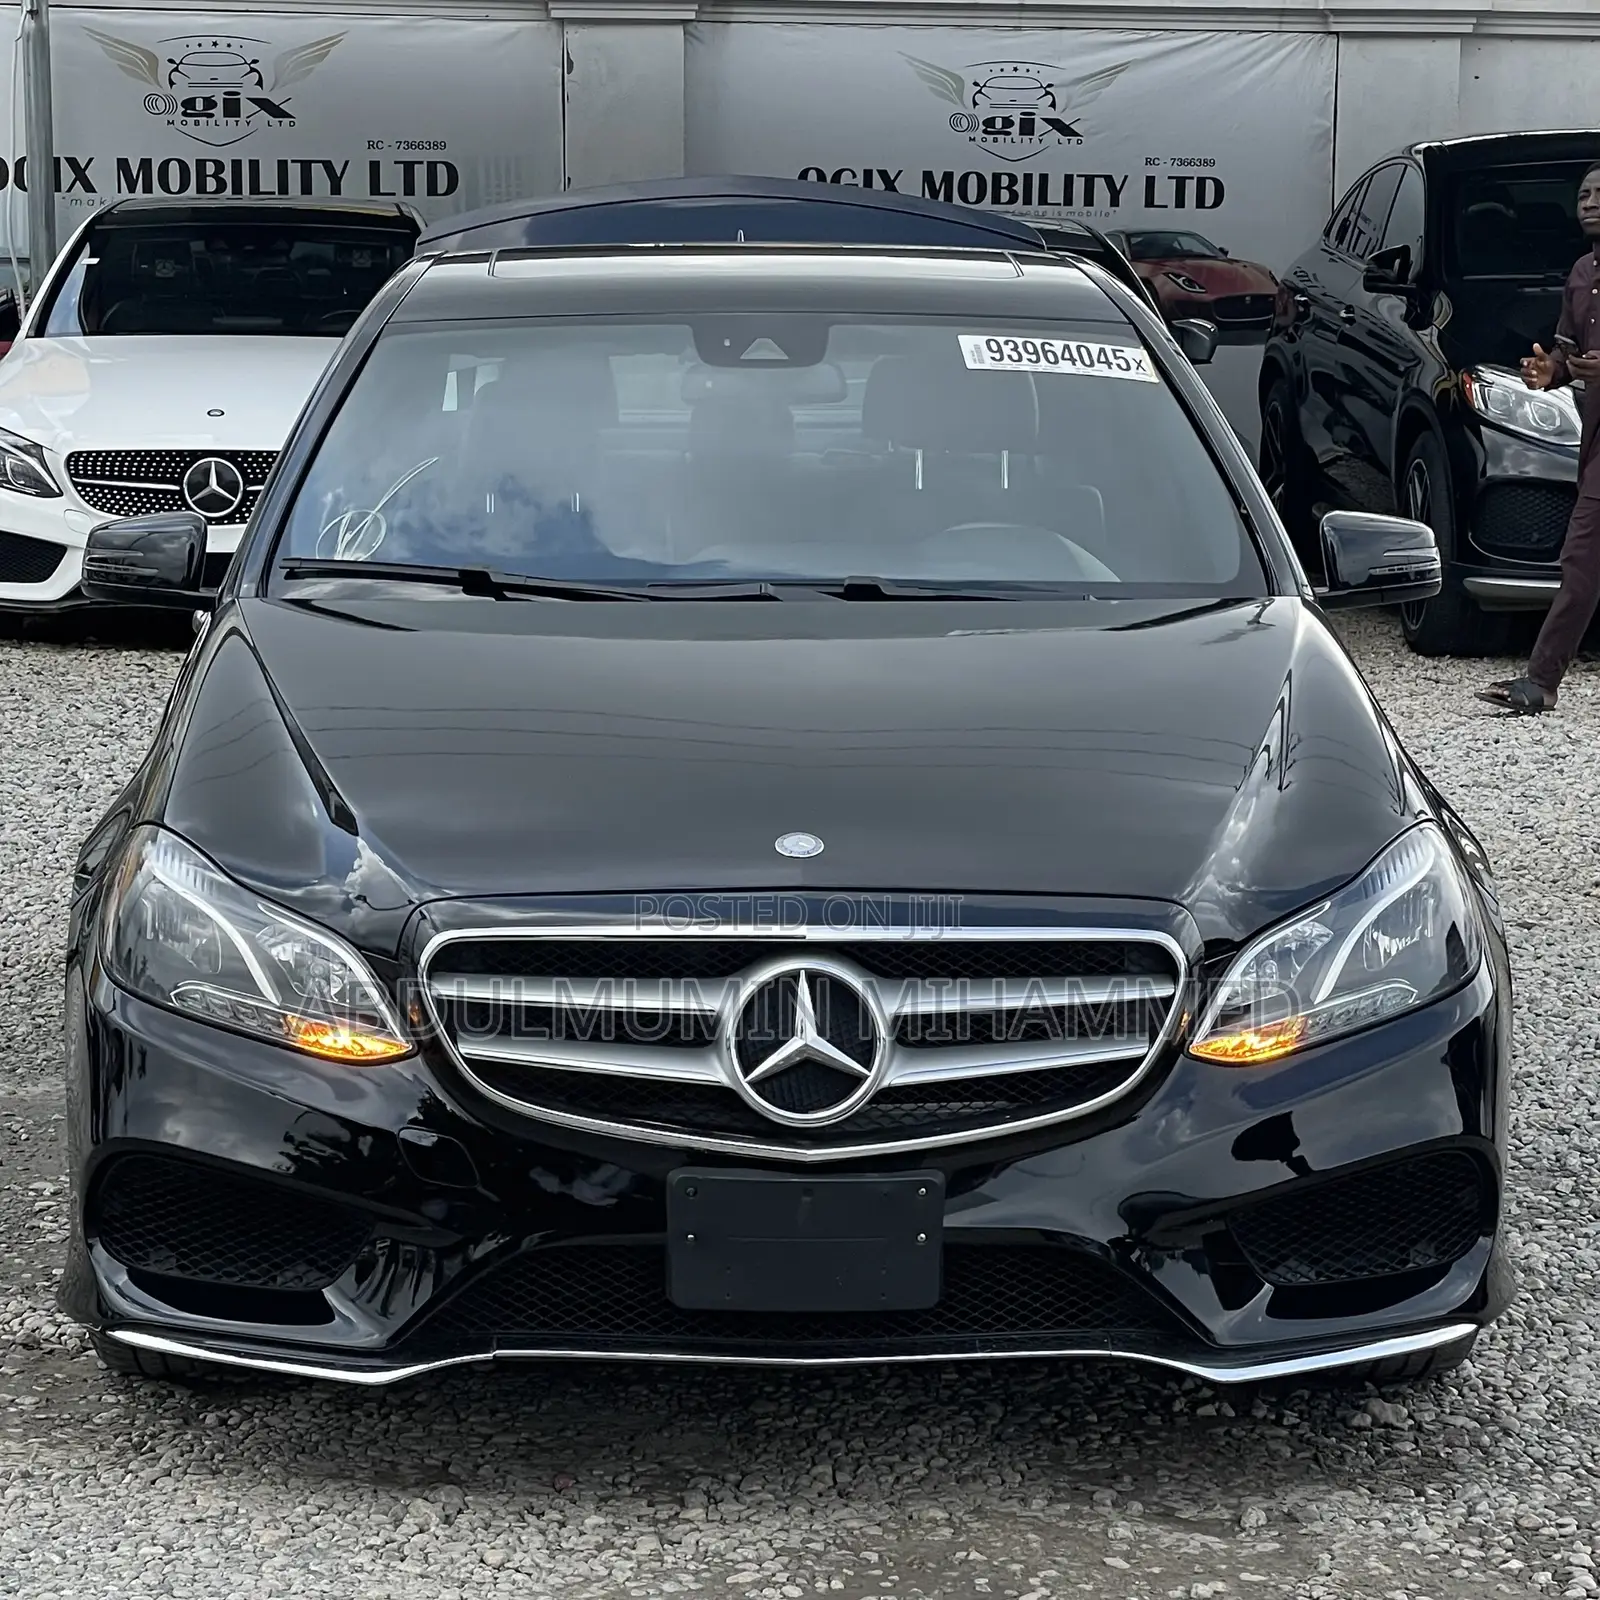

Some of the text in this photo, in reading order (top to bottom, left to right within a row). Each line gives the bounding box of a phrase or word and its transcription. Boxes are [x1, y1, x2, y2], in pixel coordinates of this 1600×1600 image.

[166, 119, 297, 127] MOBILITY LTD
[367, 140, 384, 150] RC
[395, 140, 447, 151] 7366389
[968, 136, 1044, 144] MOBILITY
[1144, 157, 1160, 166] RC
[1170, 157, 1216, 167] 7366389
[0, 156, 459, 196] IX MOBILITY LTD
[922, 170, 1129, 207] MOBILITY
[1144, 175, 1225, 209] LTD
[985, 338, 1131, 371] 93964045
